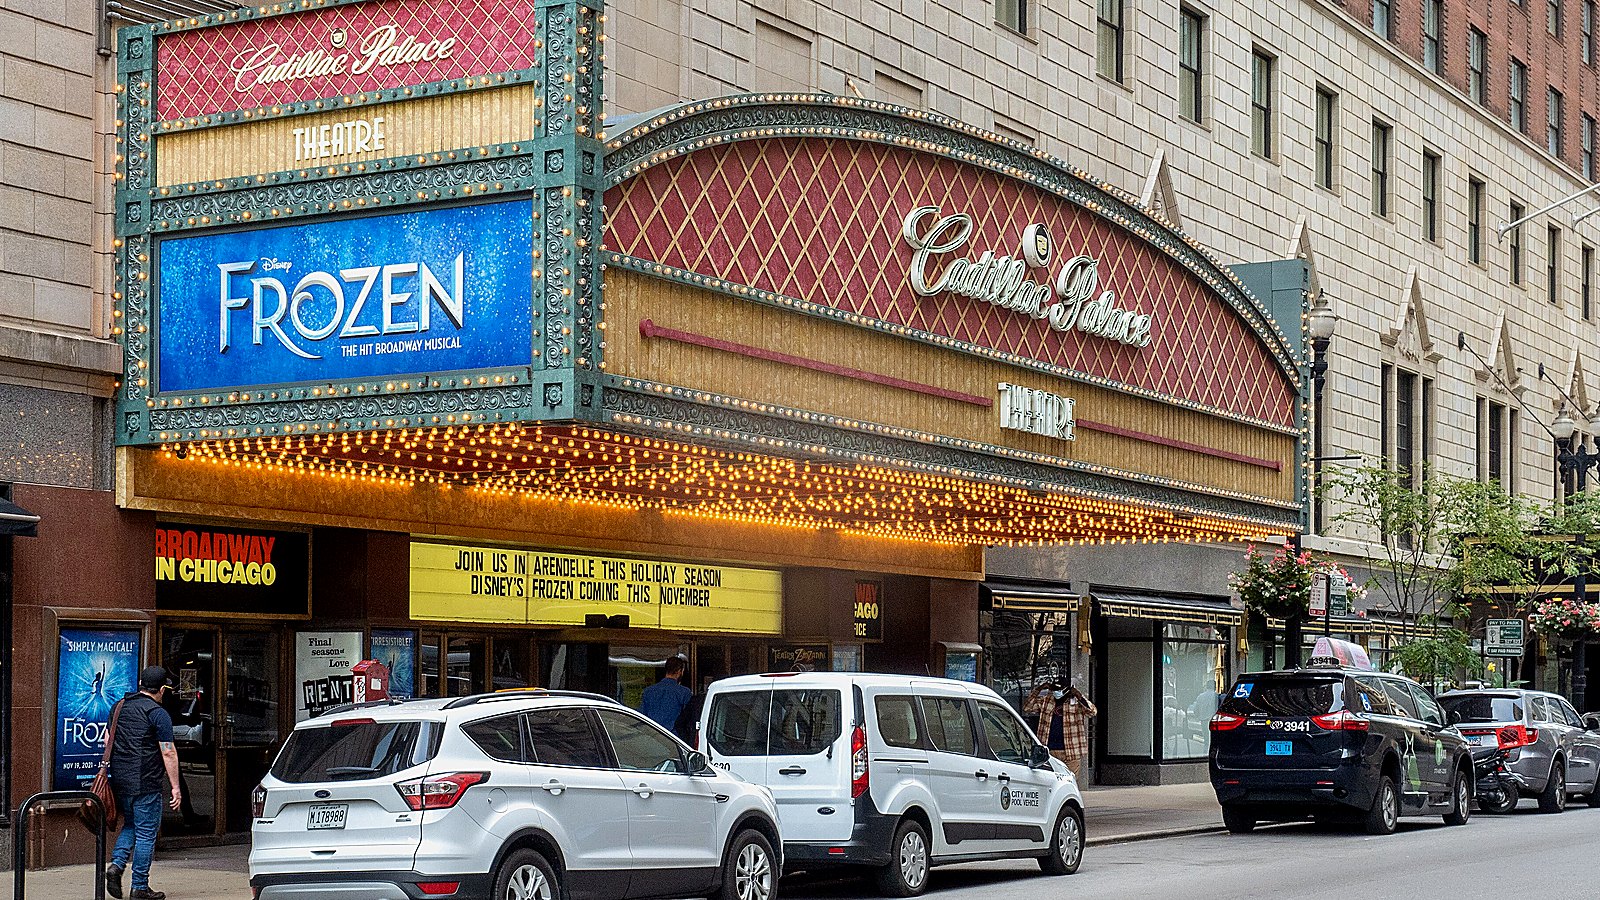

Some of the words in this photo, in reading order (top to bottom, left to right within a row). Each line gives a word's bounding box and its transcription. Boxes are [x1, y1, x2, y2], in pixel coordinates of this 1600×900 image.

[231, 43, 348, 93] Cadillac
[352, 25, 456, 74] Palace
[293, 118, 385, 160] THEATRE
[261, 257, 293, 273] Disney
[903, 206, 1051, 319] Cadillac
[1049, 255, 1152, 348] Palace
[217, 251, 464, 359] FROZEN
[341, 345, 358, 357] THE
[359, 343, 373, 355] HIT
[375, 340, 423, 354] BROADWAY
[424, 337, 461, 350] MUSICAL
[998, 382, 1076, 441] THEATRE
[155, 528, 276, 566] BROADWAY
[155, 556, 175, 580] IN
[179, 557, 277, 586] CHICAGO
[454, 550, 484, 571] JOIN
[492, 552, 508, 573] US
[514, 554, 526, 575] IN
[533, 556, 595, 578] ARENDELLE
[601, 560, 626, 580] THIS
[631, 562, 677, 583] HOLIDAY
[684, 567, 721, 587] SEASON
[470, 575, 524, 596] DISNEY'S
[532, 578, 574, 600] FROZEN
[579, 581, 619, 601] COMING
[626, 583, 650, 603] THIS
[660, 586, 710, 607] NOVEMBER
[308, 638, 332, 646] Final
[311, 648, 340, 656] season
[329, 659, 350, 668] Love
[1313, 657, 1332, 665] 3941
[304, 680, 352, 705] RENT
[63, 717, 108, 748] FROZ
[1284, 721, 1310, 731] 3941
[1011, 790, 1024, 798] CITY
[1025, 791, 1039, 799] WIDE
[1023, 799, 1039, 807] VEHICLE
